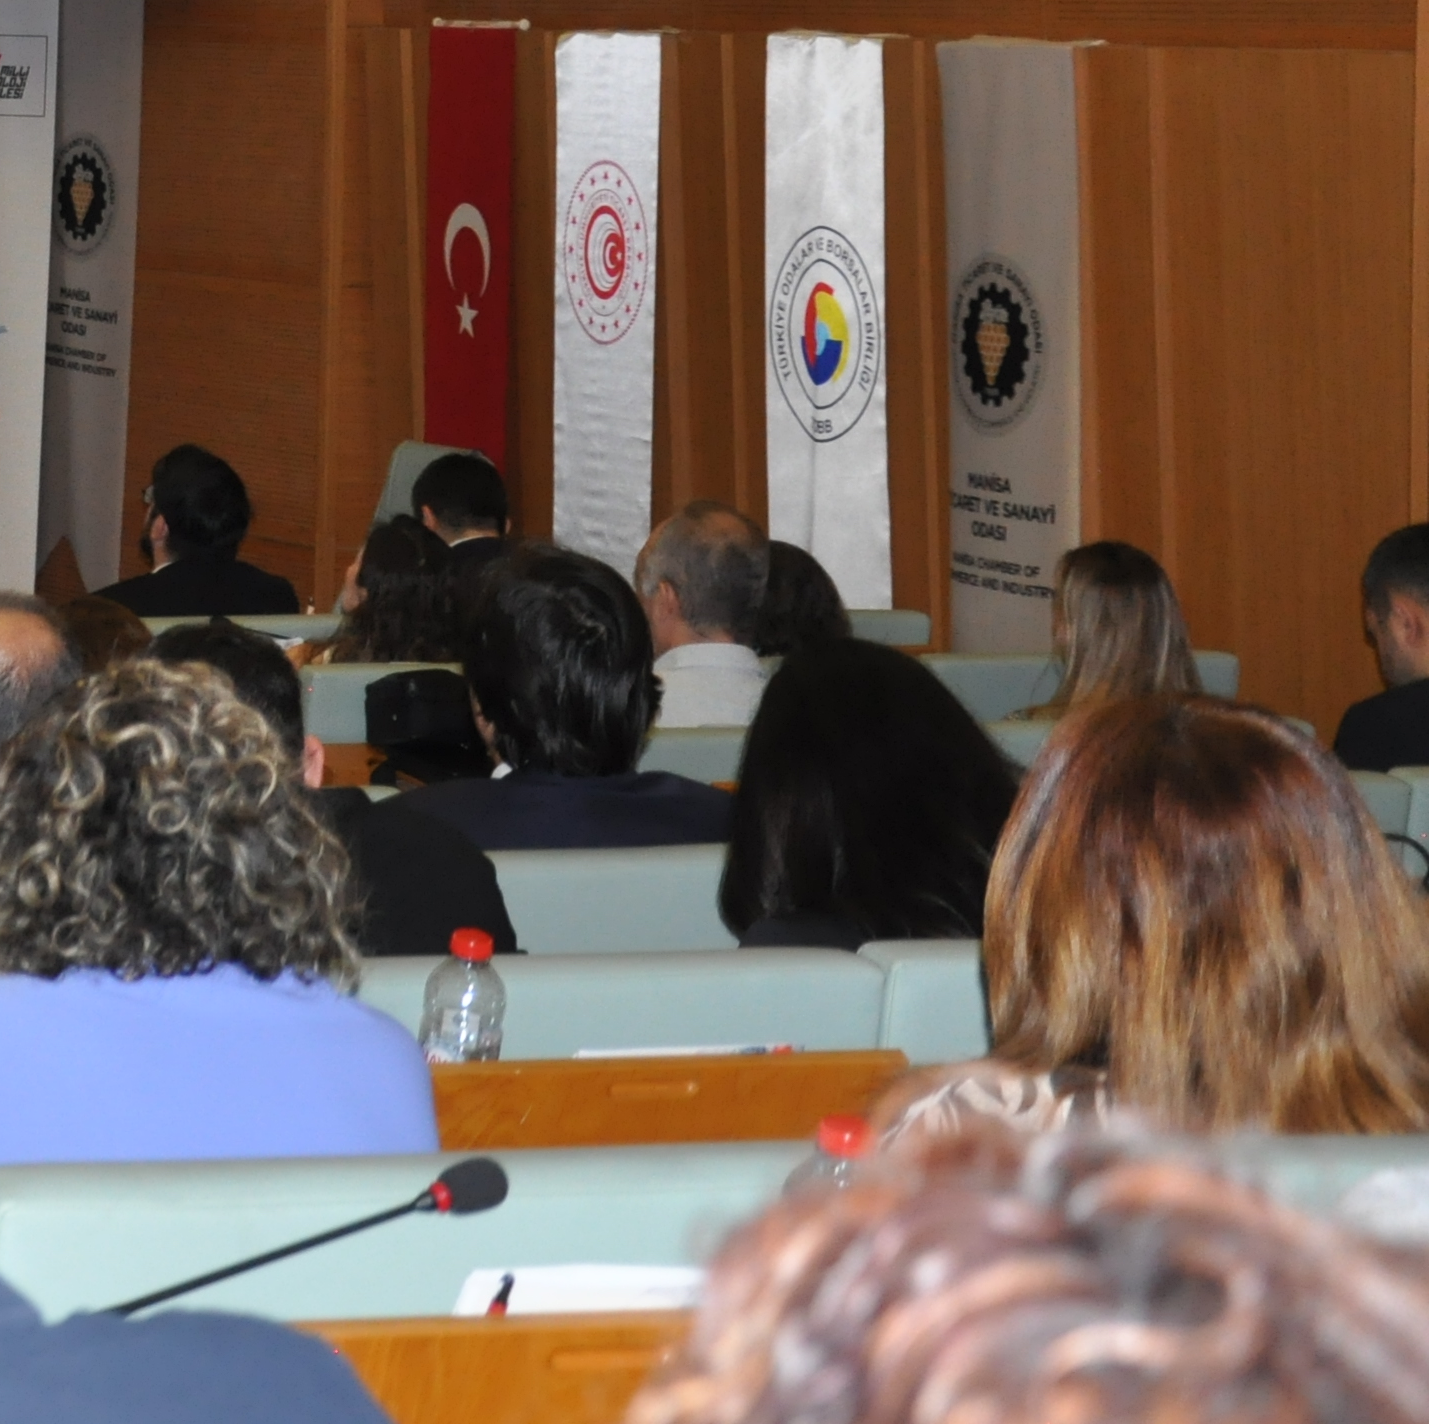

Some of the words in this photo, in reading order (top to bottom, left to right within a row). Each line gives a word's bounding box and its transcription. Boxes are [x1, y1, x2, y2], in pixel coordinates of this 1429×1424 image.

[71, 305, 83, 319] VE
[984, 498, 1000, 517] VE
[1002, 501, 1057, 525] SANAYİ
